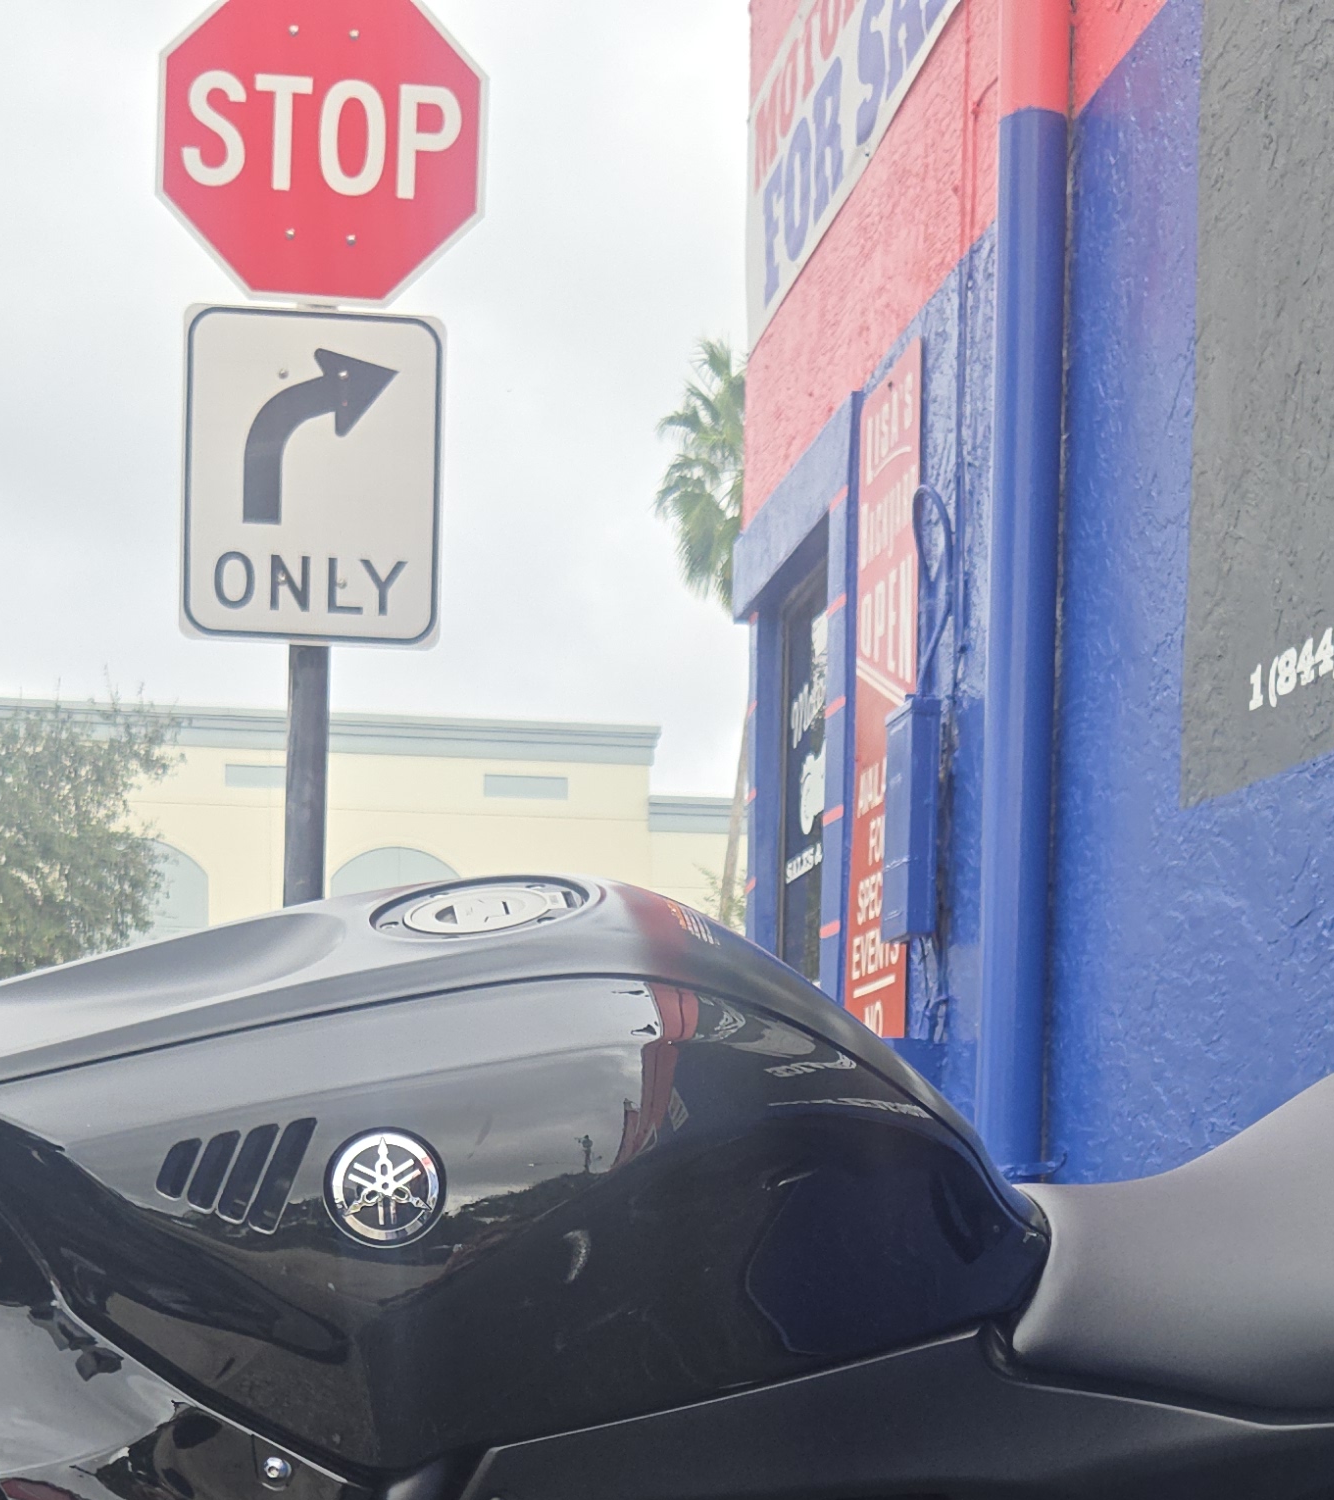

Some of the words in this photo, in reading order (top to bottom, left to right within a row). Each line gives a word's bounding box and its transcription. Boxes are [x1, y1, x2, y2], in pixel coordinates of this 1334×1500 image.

[180, 69, 463, 200] STOP
[754, 0, 856, 196] MOTO
[763, 55, 844, 311] FOR
[856, 0, 948, 146] SA
[212, 550, 409, 617] ONLY
[860, 553, 914, 685] OPEN
[856, 871, 883, 926] SPEC
